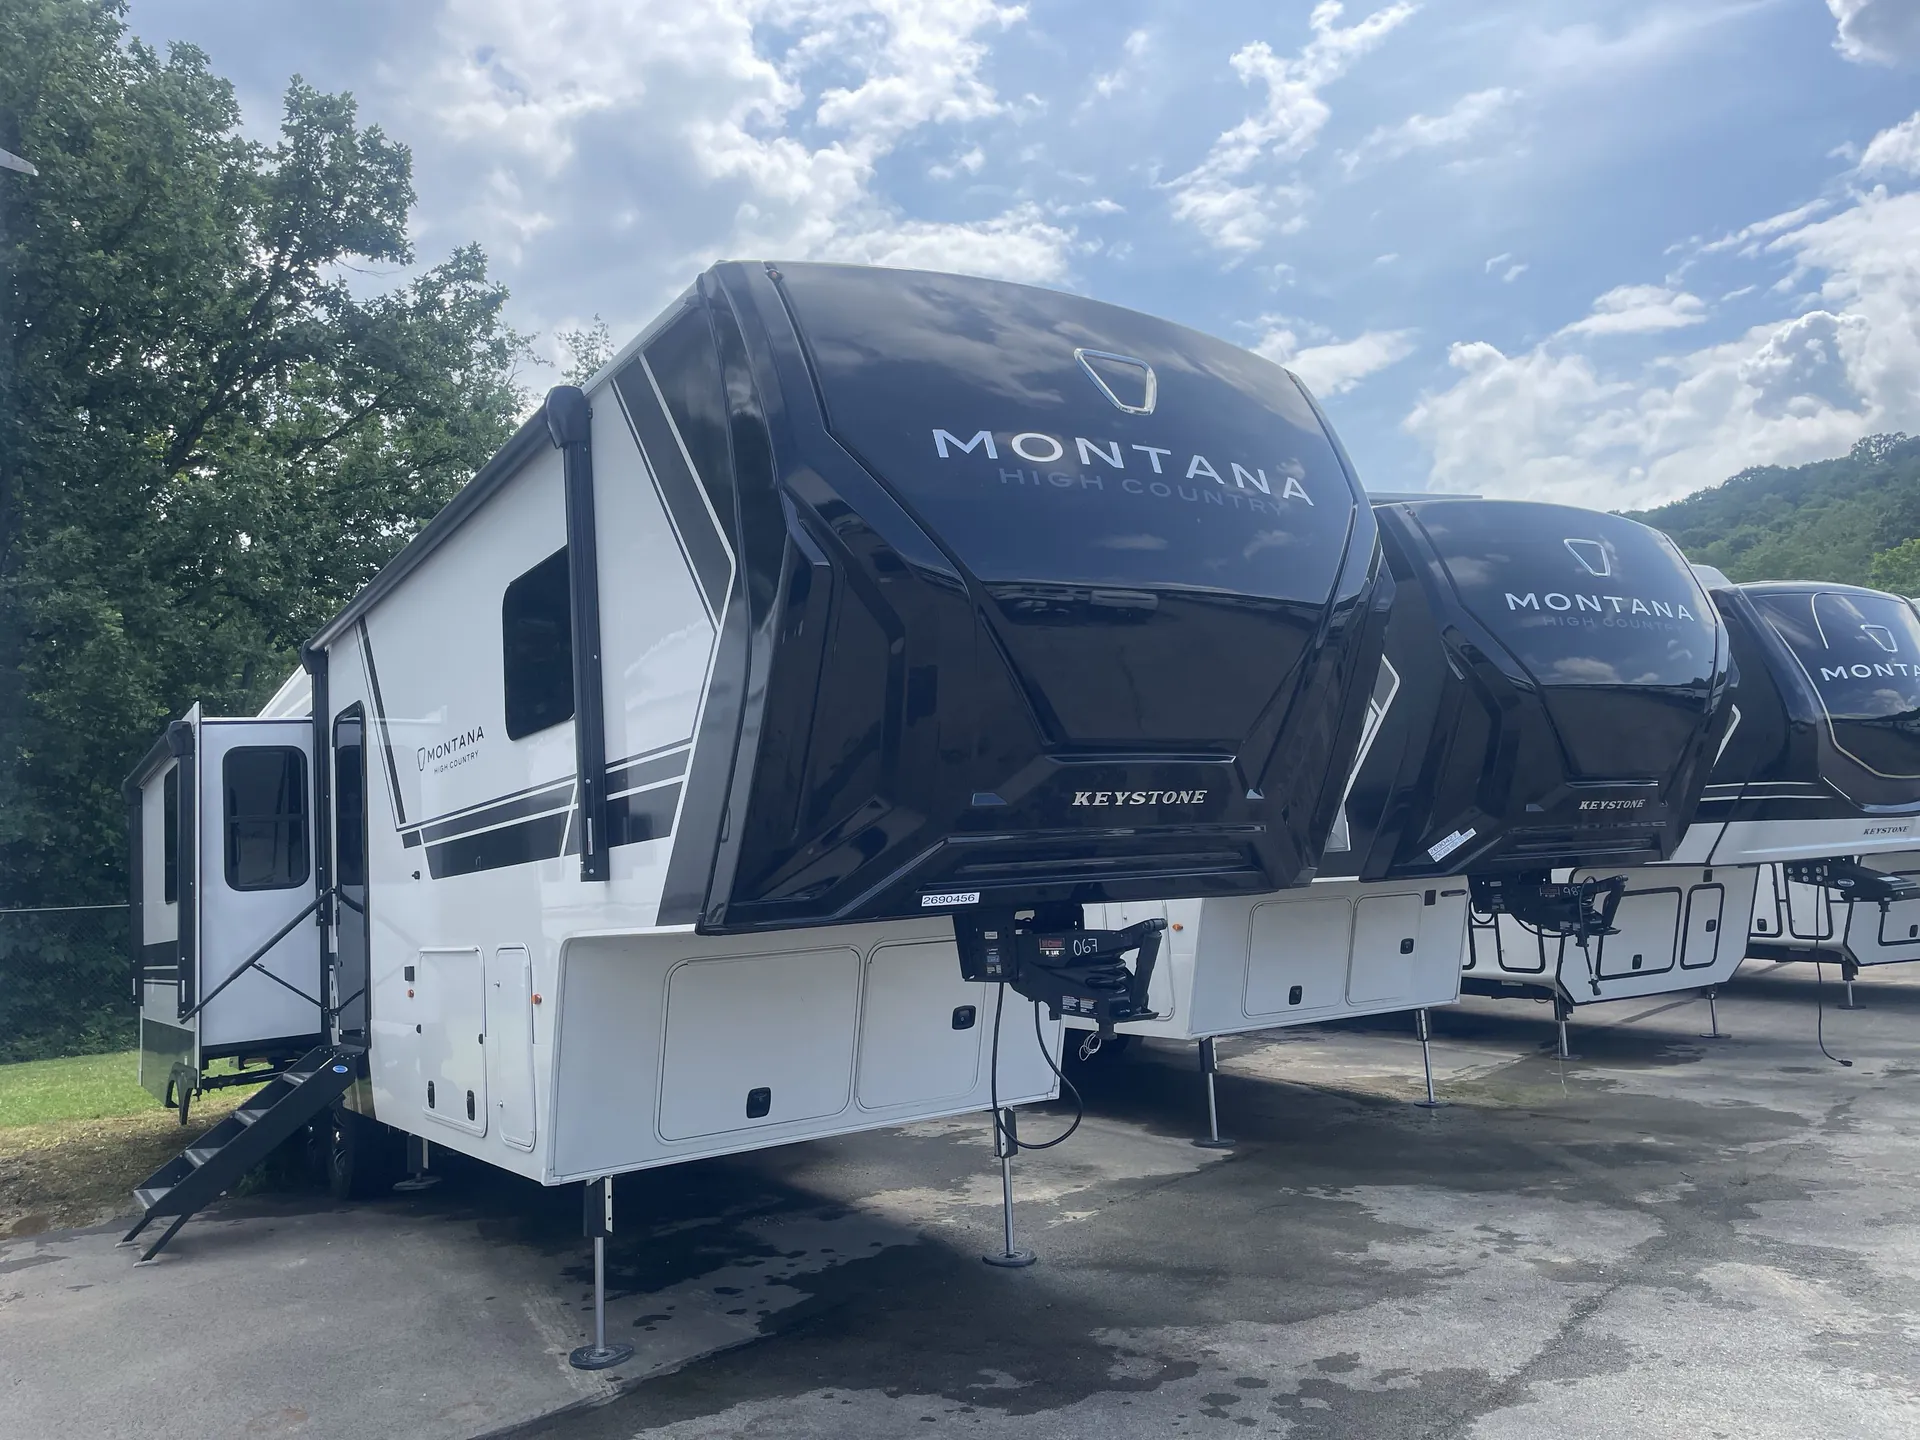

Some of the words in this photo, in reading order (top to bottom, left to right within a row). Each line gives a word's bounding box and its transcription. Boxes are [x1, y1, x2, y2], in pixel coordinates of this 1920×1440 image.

[932, 429, 1314, 506] MONTANA
[999, 468, 1104, 490] HIGH
[1122, 478, 1285, 516] COUNTRY
[1505, 593, 1694, 622] MONTANA
[1543, 616, 1595, 627] HIGH
[427, 726, 484, 763] MONTANA
[434, 764, 448, 774] HIGH
[449, 750, 479, 769] COUNTRY
[1072, 790, 1208, 806] KEYSTONE
[1579, 799, 1645, 810] KEYSTONE
[1863, 826, 1909, 835] KEYSTONE
[922, 893, 975, 904] 2690456
[1073, 938, 1098, 956] 067
